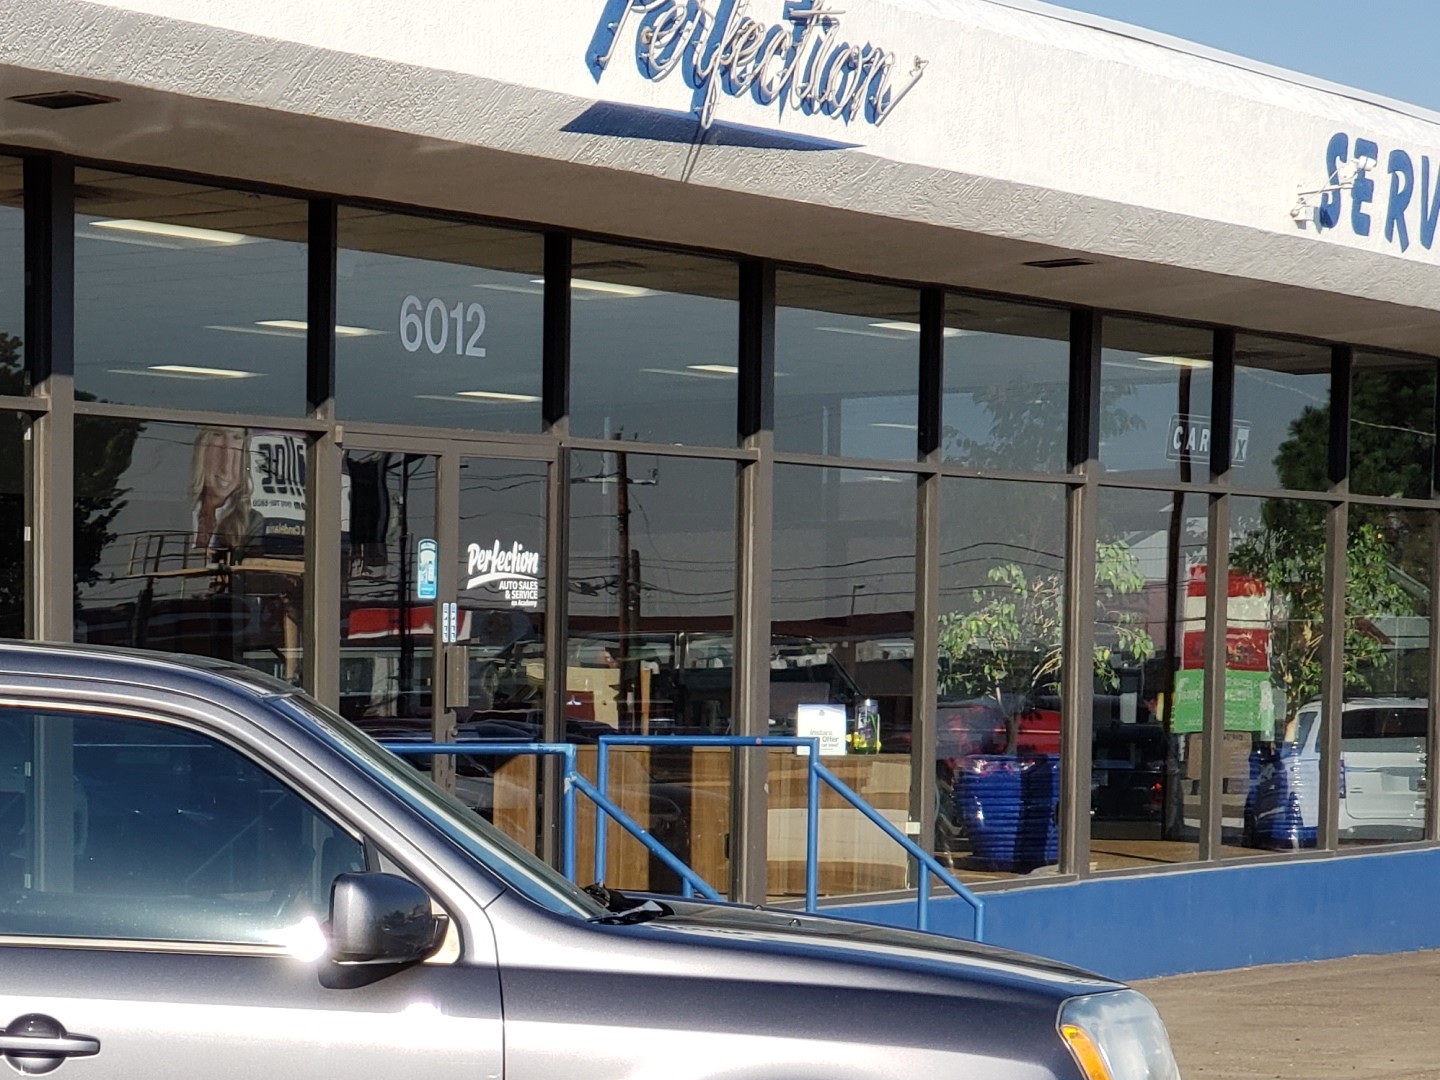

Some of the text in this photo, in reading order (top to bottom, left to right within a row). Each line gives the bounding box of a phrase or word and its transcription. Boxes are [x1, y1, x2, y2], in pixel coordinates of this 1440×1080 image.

[400, 295, 486, 357] 6012
[467, 539, 539, 575] Perfection
[499, 581, 538, 590] AUTO SALES
[505, 591, 538, 599] & SERVICE
